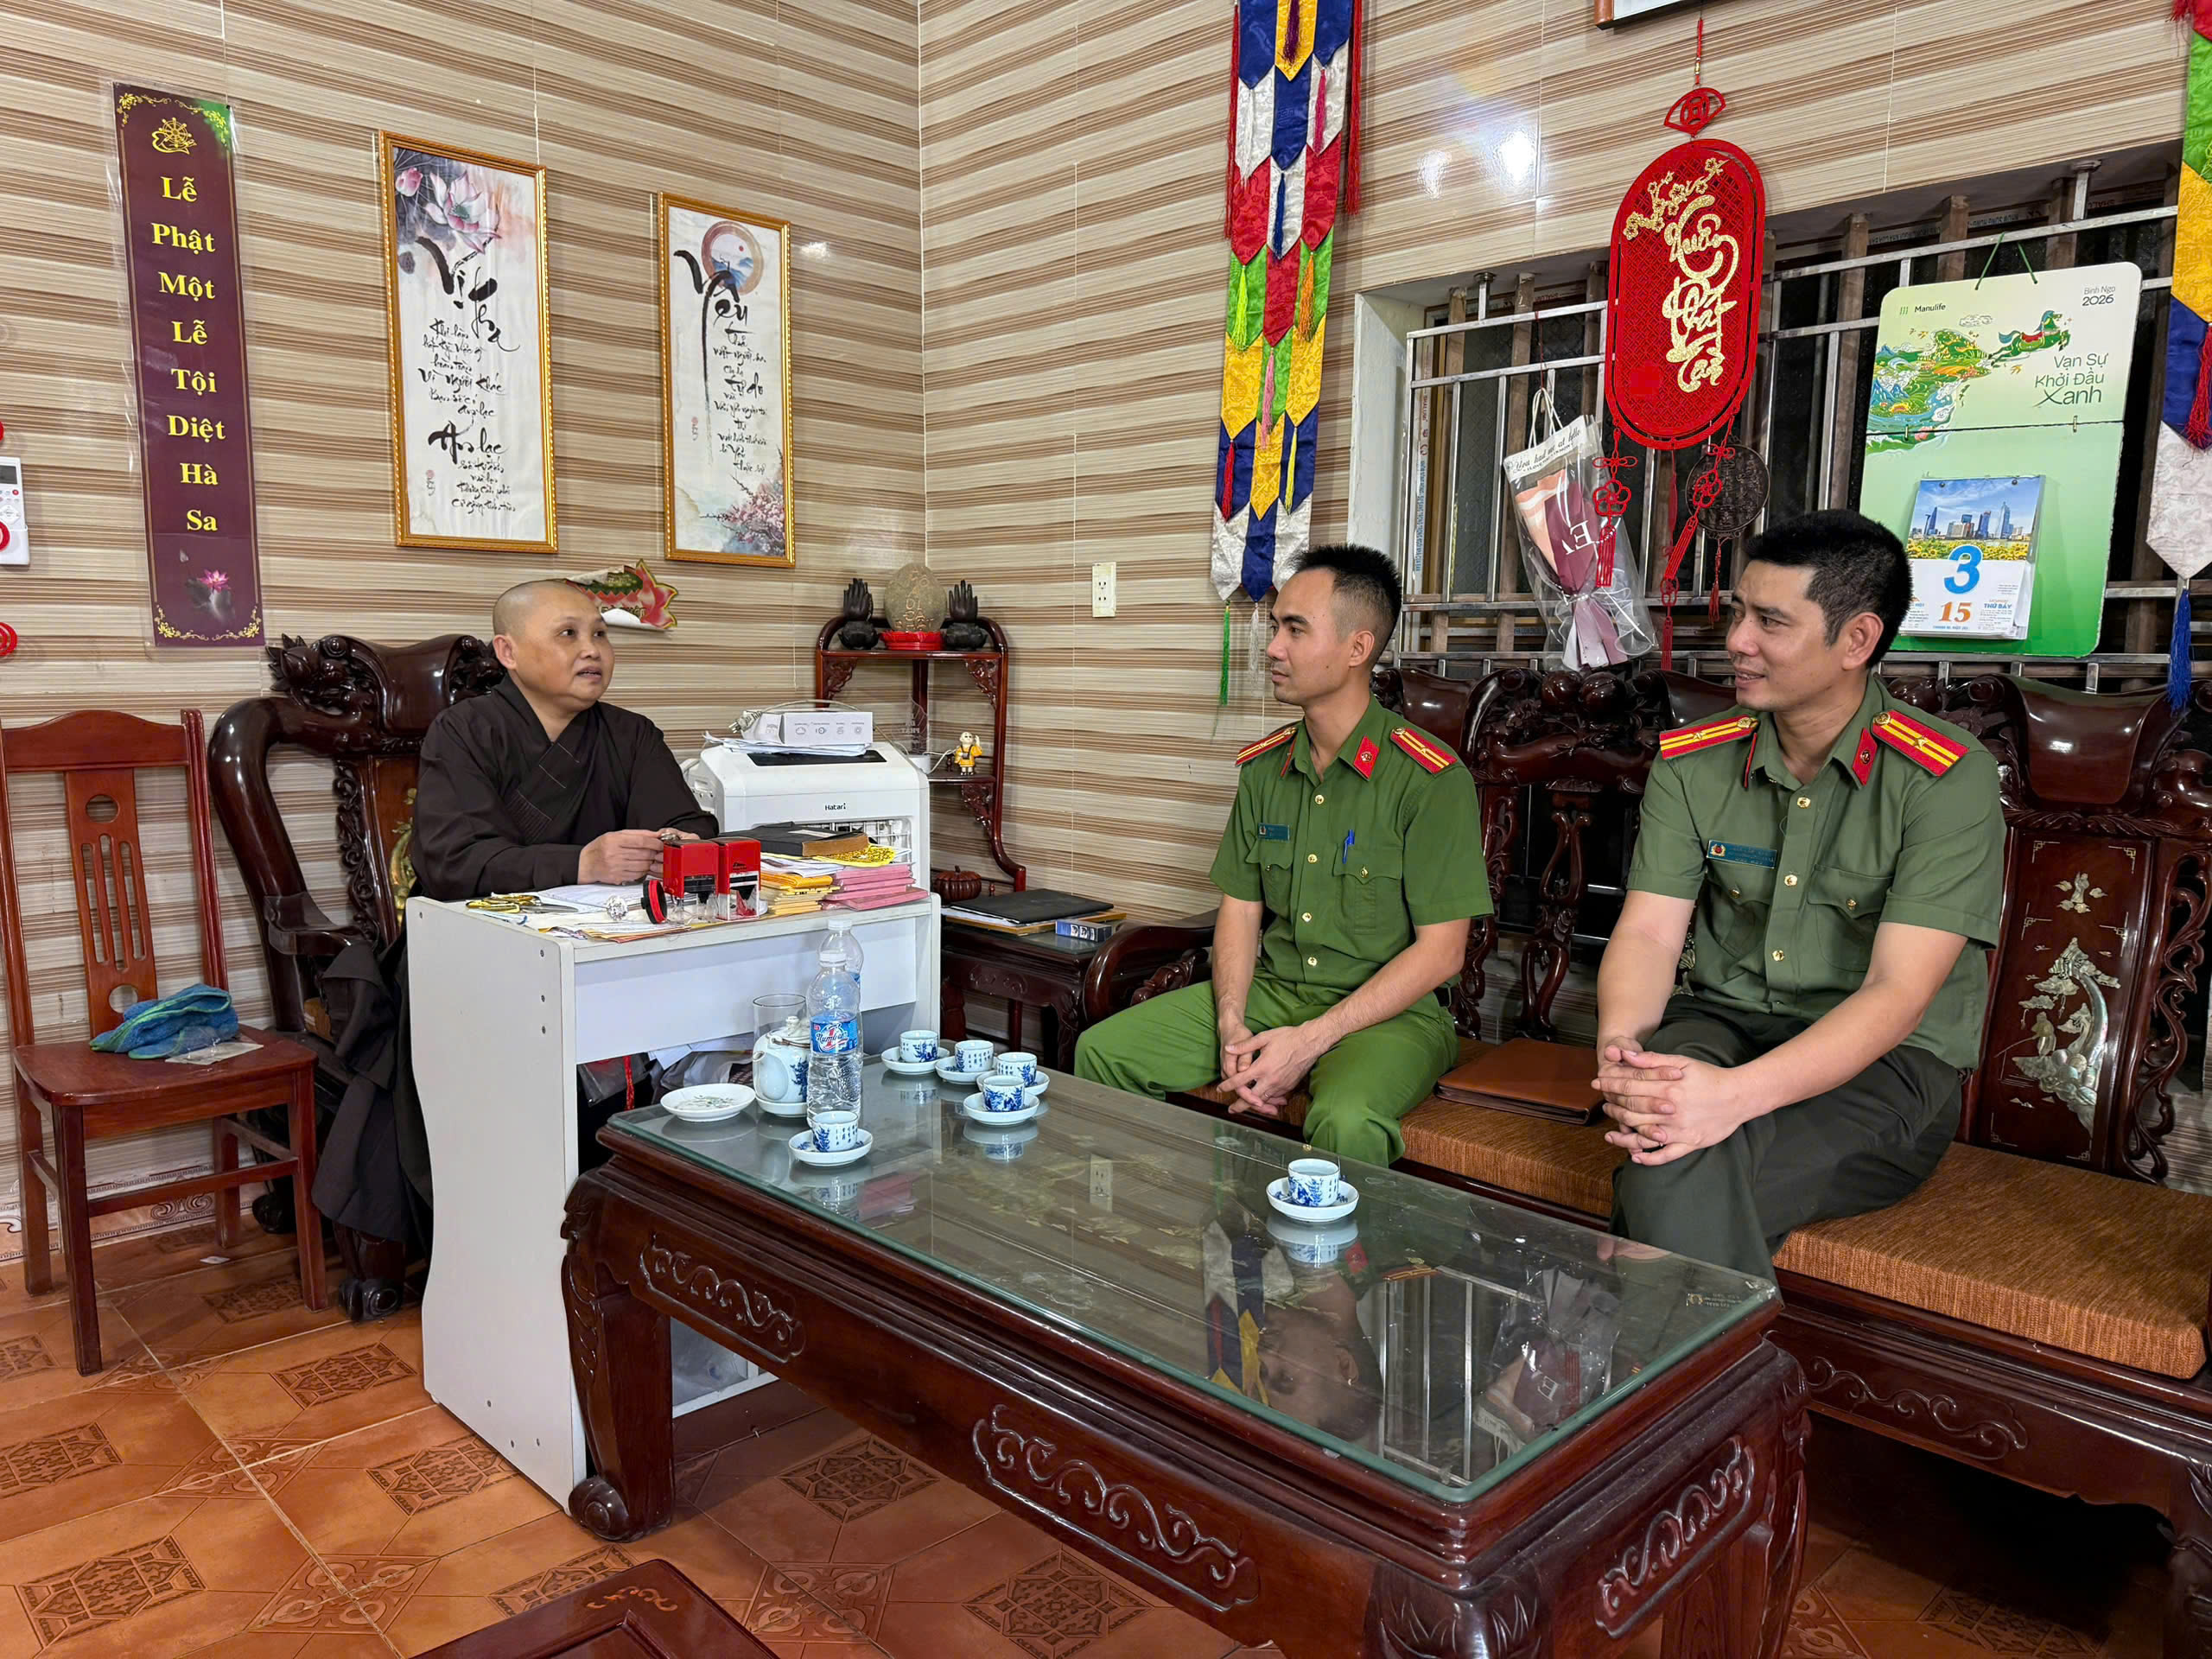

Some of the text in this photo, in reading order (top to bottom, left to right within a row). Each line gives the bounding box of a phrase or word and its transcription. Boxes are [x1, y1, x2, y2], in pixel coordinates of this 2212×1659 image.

[161, 175, 198, 202] Lễ
[150, 222, 216, 255] Phật
[158, 271, 216, 302] Một
[1914, 302, 1946, 313] Manulife
[2082, 294, 2114, 307] 2026
[171, 320, 207, 345] Lễ
[2054, 353, 2108, 371] Vạn Sự
[171, 368, 217, 396] Tội
[2035, 367, 2105, 388] Khởi Đầu
[2032, 385, 2102, 407] Xanh
[167, 415, 226, 443] Diệt
[180, 463, 218, 486] Hà
[187, 510, 218, 531] Sa
[1944, 544, 1983, 595] 3
[1939, 601, 1972, 622] 15
[824, 803, 846, 811] Hatari
